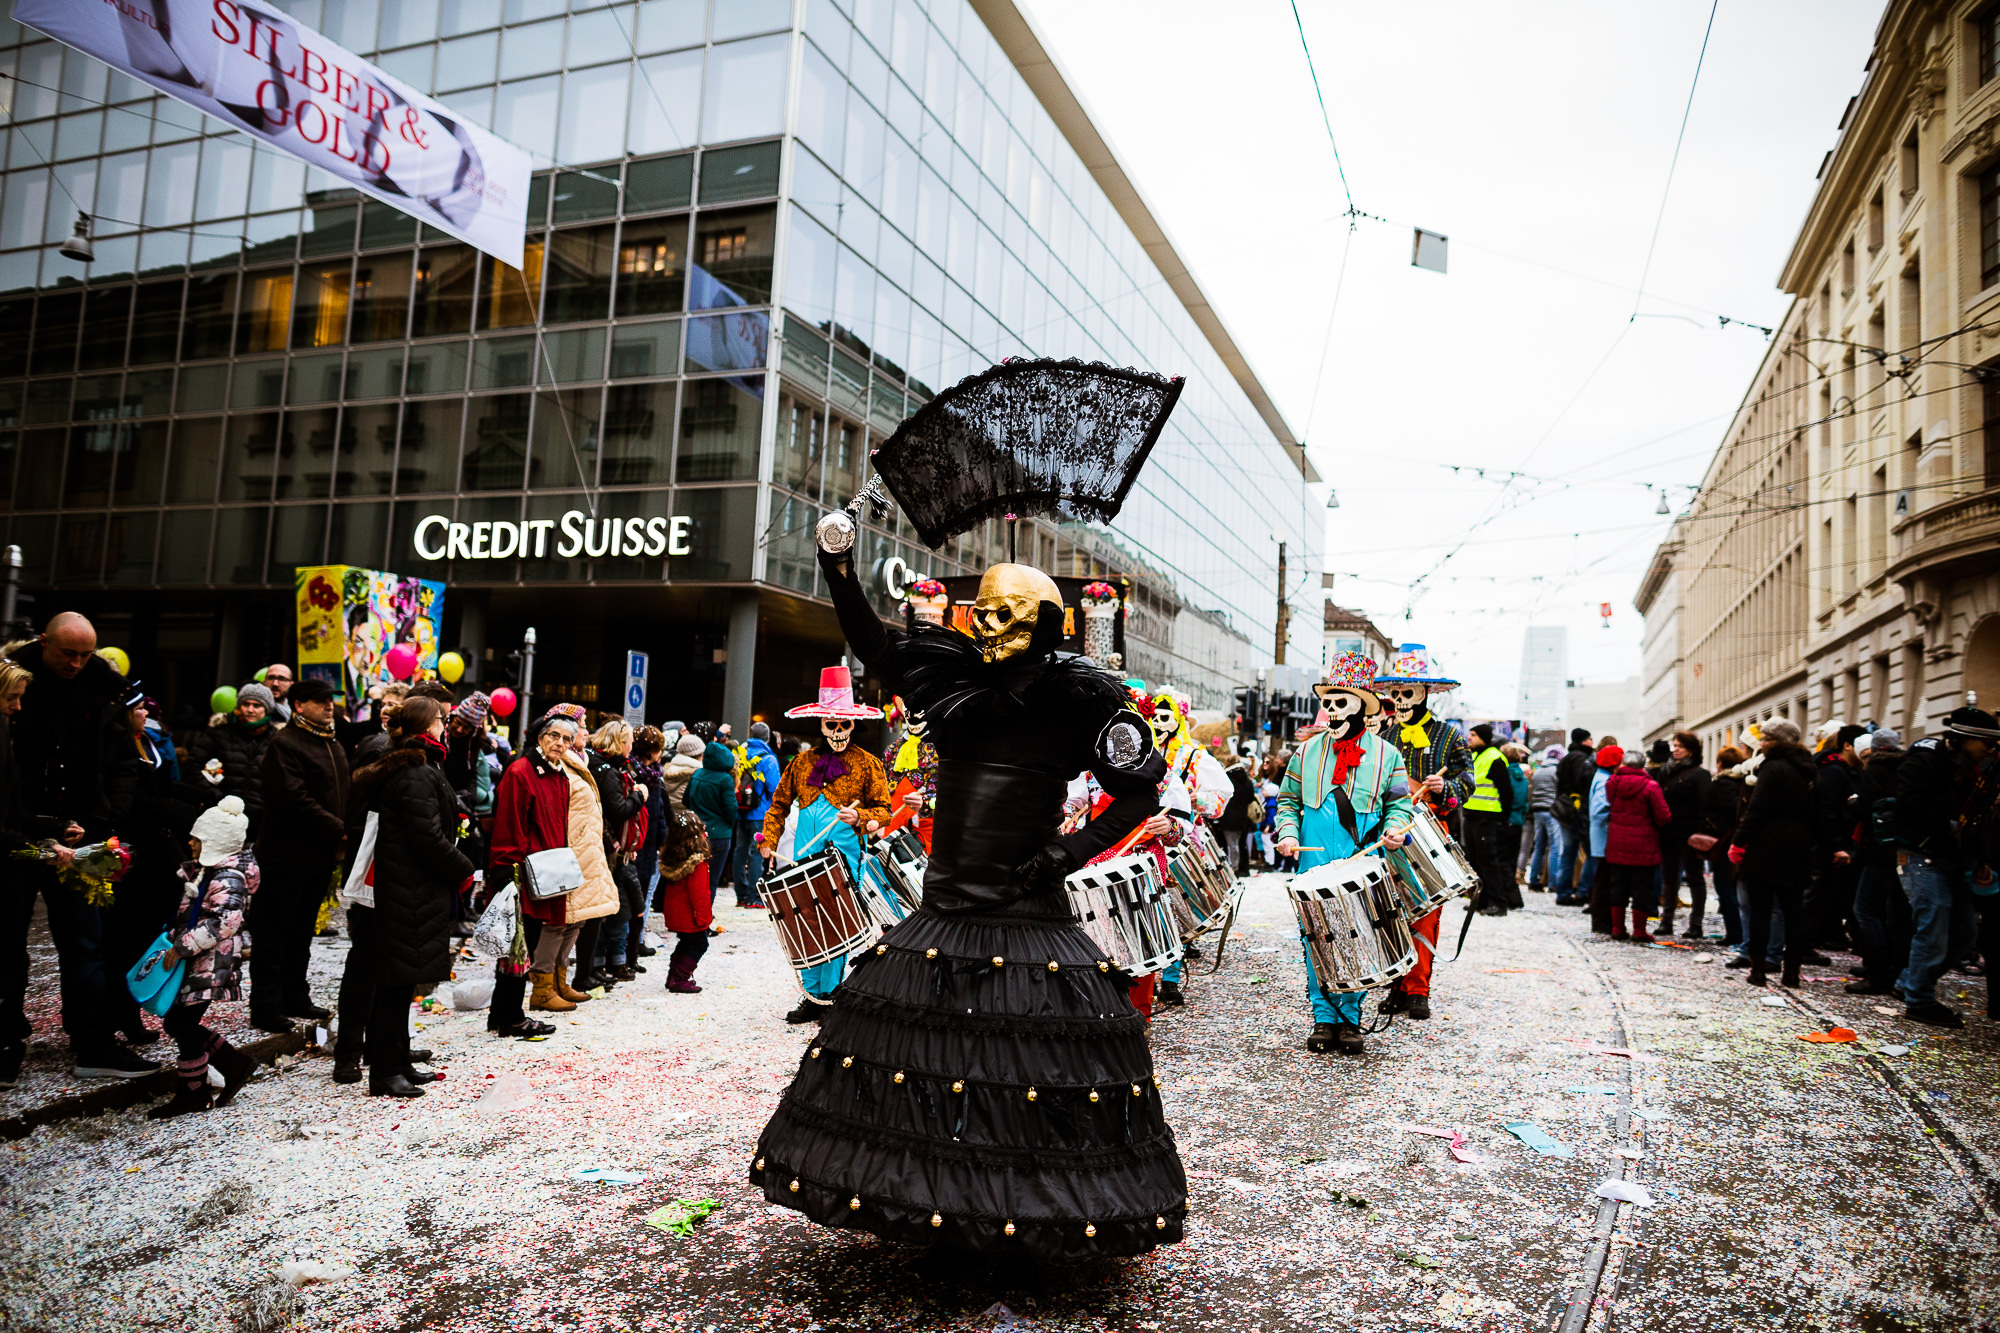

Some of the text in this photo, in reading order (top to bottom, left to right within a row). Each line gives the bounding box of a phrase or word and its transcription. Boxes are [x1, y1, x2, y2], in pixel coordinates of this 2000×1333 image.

[212, 0, 430, 150] SILBER &
[256, 79, 391, 175] GOLD
[413, 510, 691, 561] CREDIT SUISSE
[1896, 495, 1908, 511] A
